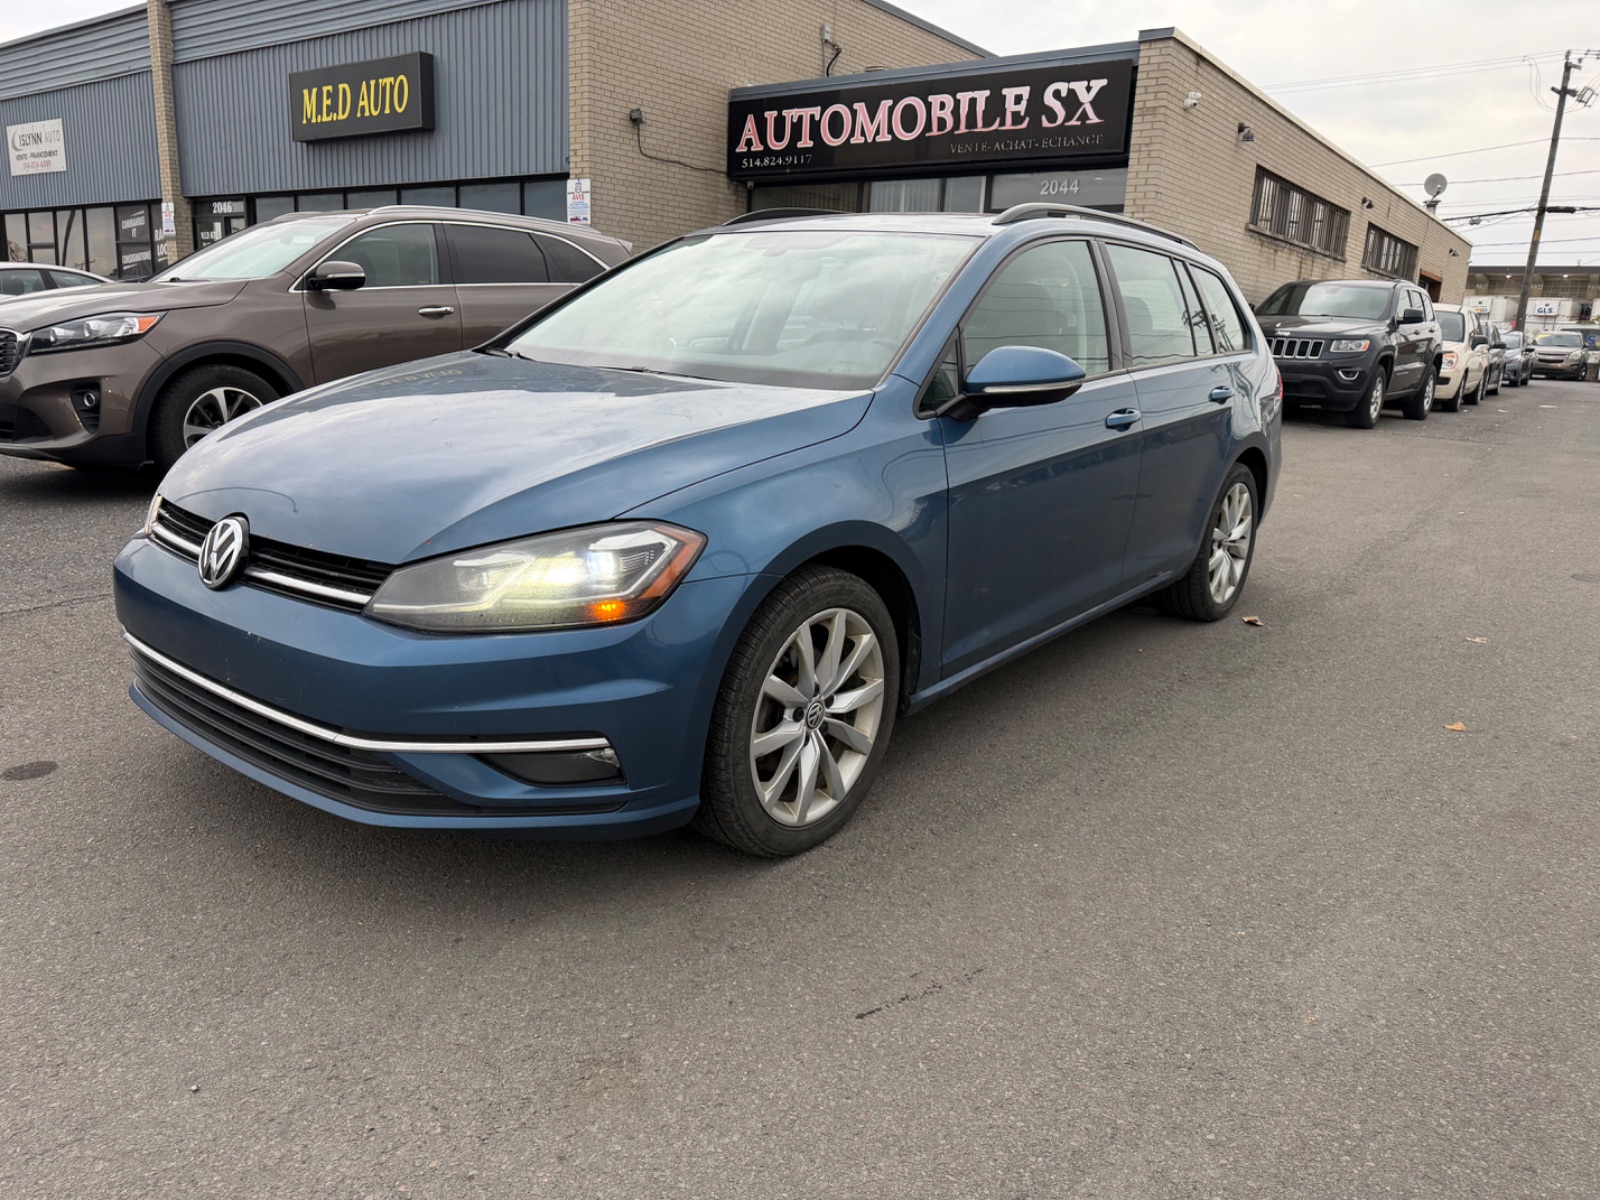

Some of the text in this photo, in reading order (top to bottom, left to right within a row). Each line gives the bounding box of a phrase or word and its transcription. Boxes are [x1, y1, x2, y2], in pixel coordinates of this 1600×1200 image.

[302, 74, 409, 125] M.E.D AUTO
[735, 79, 1108, 153] AUTOMOBILE SX
[45, 130, 61, 143] AUTO
[1039, 179, 1080, 195] 2044
[572, 193, 585, 201] AVIS
[212, 201, 233, 214] 2046
